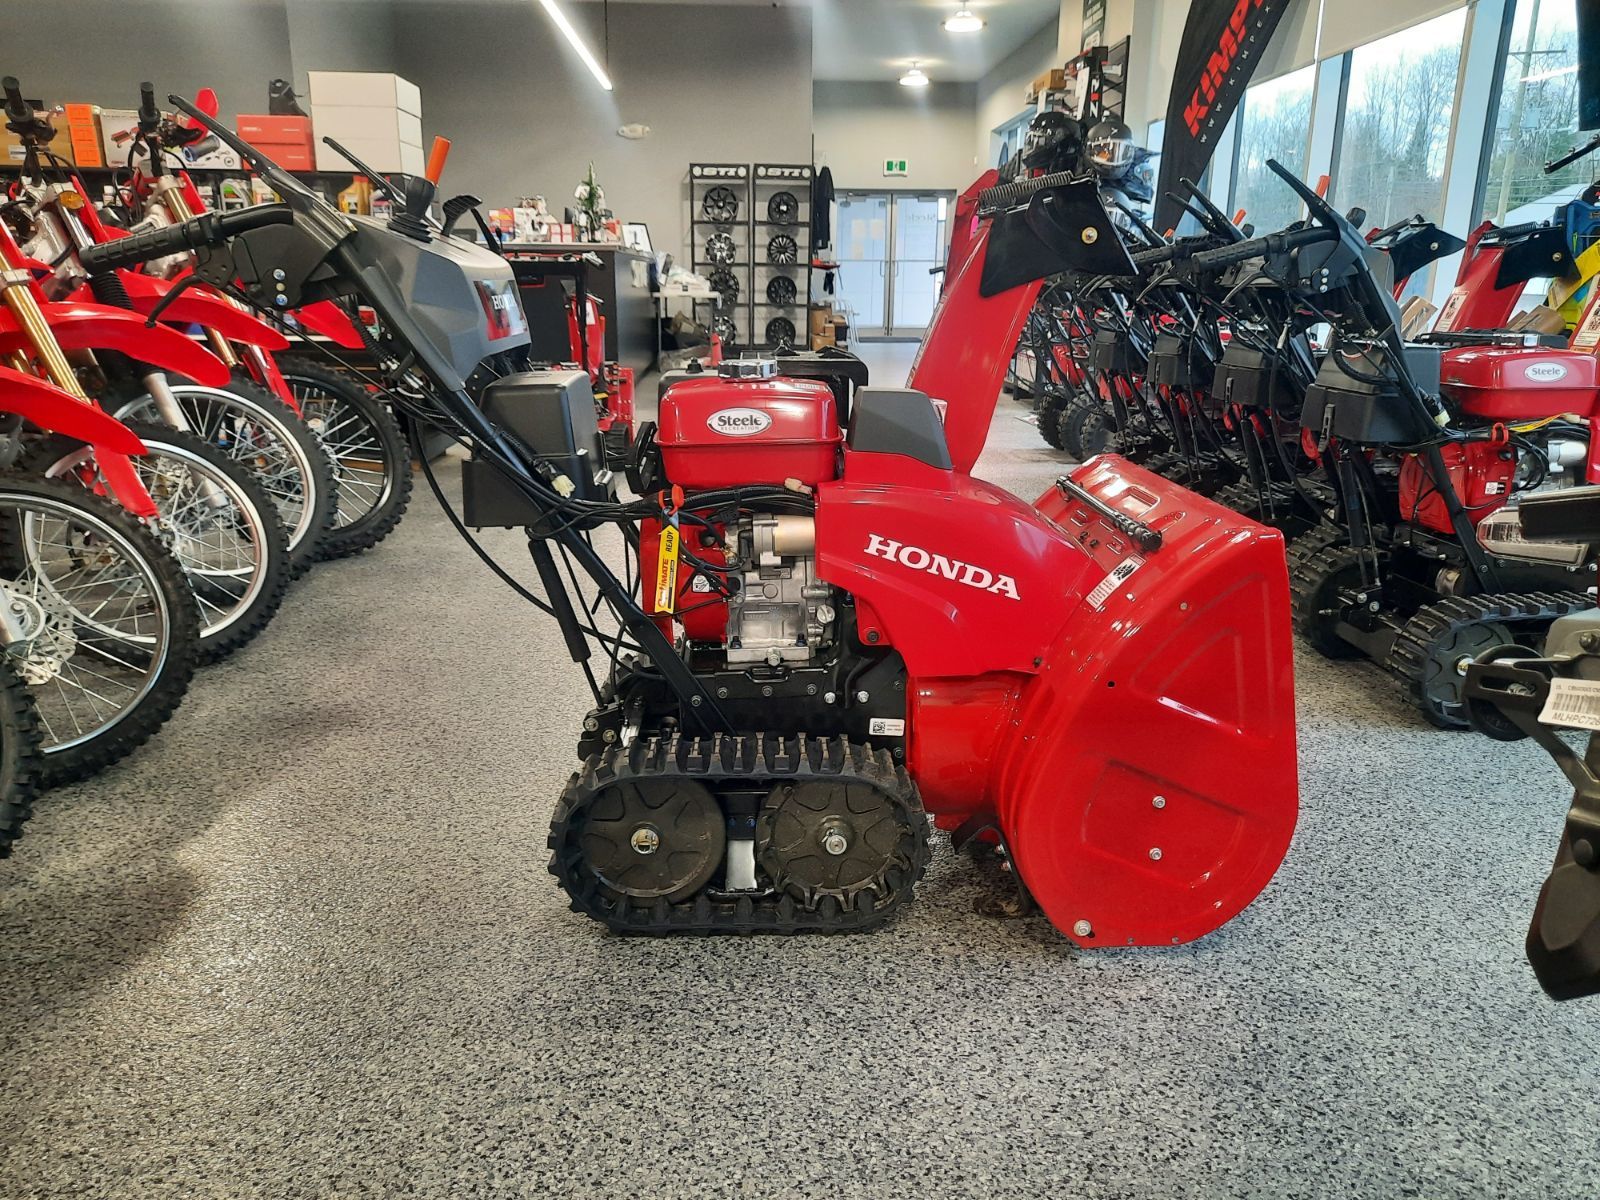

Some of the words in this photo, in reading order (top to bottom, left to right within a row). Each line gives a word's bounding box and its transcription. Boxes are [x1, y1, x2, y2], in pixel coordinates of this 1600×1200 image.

[1183, 0, 1263, 138] KIMP
[702, 167, 737, 176] STI
[767, 168, 801, 177] STI
[1531, 367, 1561, 376] Steele
[717, 414, 762, 426] Steele
[657, 557, 669, 607] OtiMATE
[665, 530, 674, 553] READY
[863, 533, 1021, 600] HONDA
